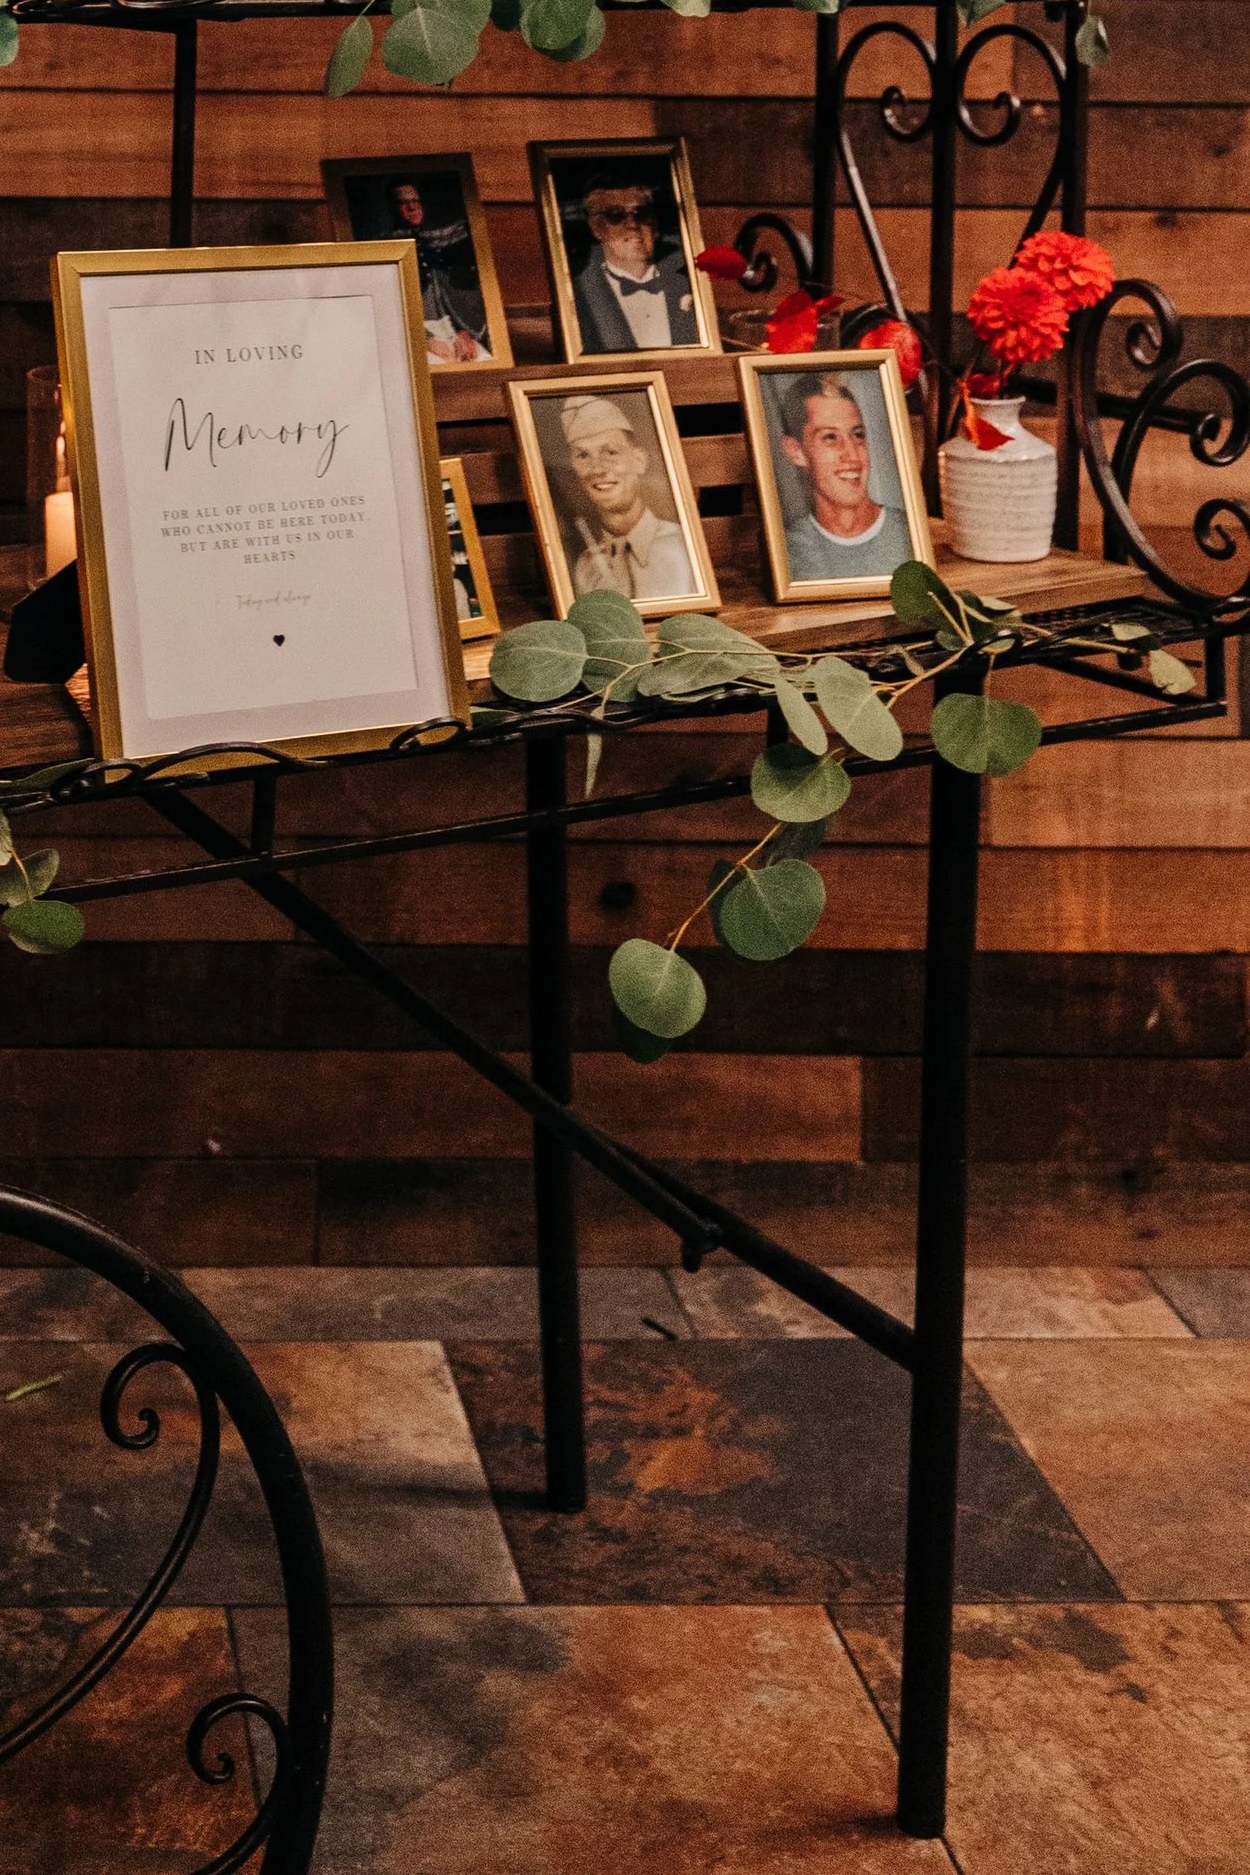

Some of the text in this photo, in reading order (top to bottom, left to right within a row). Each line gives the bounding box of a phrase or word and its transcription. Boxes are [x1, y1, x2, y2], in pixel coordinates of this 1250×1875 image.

[193, 344, 304, 365] IN LOVING
[164, 397, 350, 478] Memory
[163, 495, 365, 521] FOR ALL OF OUR LOVED ONES
[161, 526, 191, 538] WHO
[196, 521, 252, 535] CANNOT
[257, 519, 274, 530] BE
[280, 515, 315, 528] HERE
[180, 529, 354, 553] BUT ARE WITH US IN OUR
[243, 550, 296, 565] HEARTS
